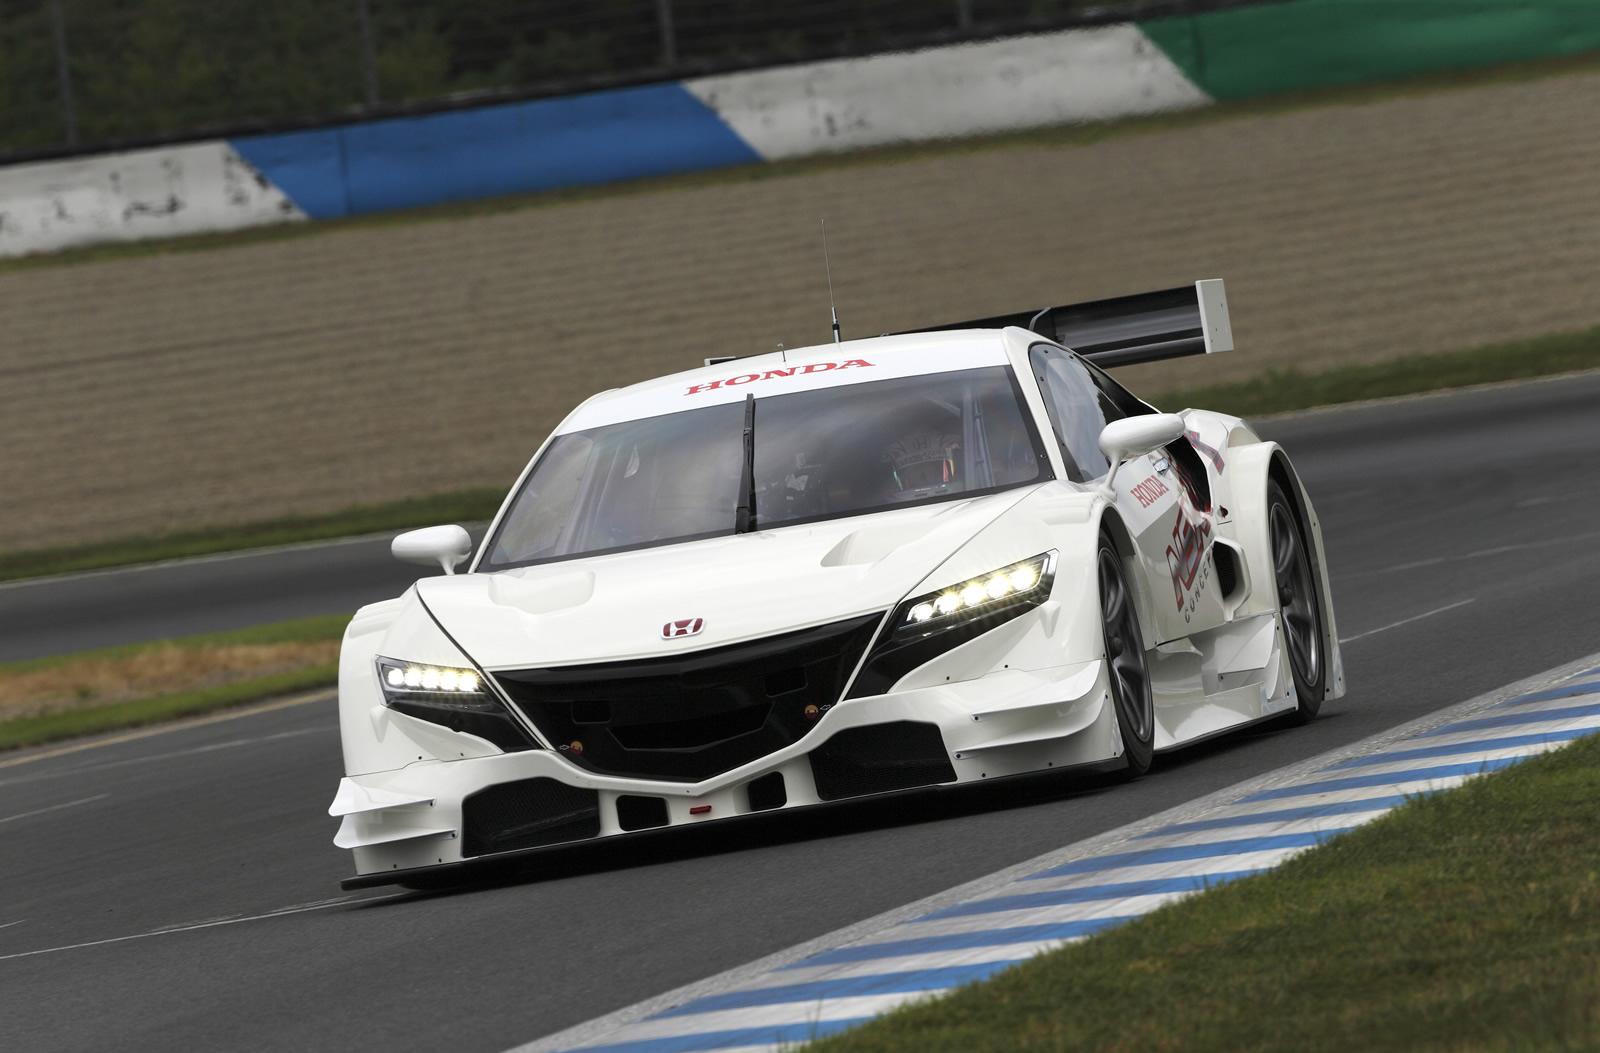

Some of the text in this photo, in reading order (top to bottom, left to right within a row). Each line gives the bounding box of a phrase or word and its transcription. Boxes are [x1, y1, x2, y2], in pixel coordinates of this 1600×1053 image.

[684, 358, 876, 396] HONDA
[1130, 474, 1170, 509] HONDA
[1184, 546, 1213, 624] CONCEP
